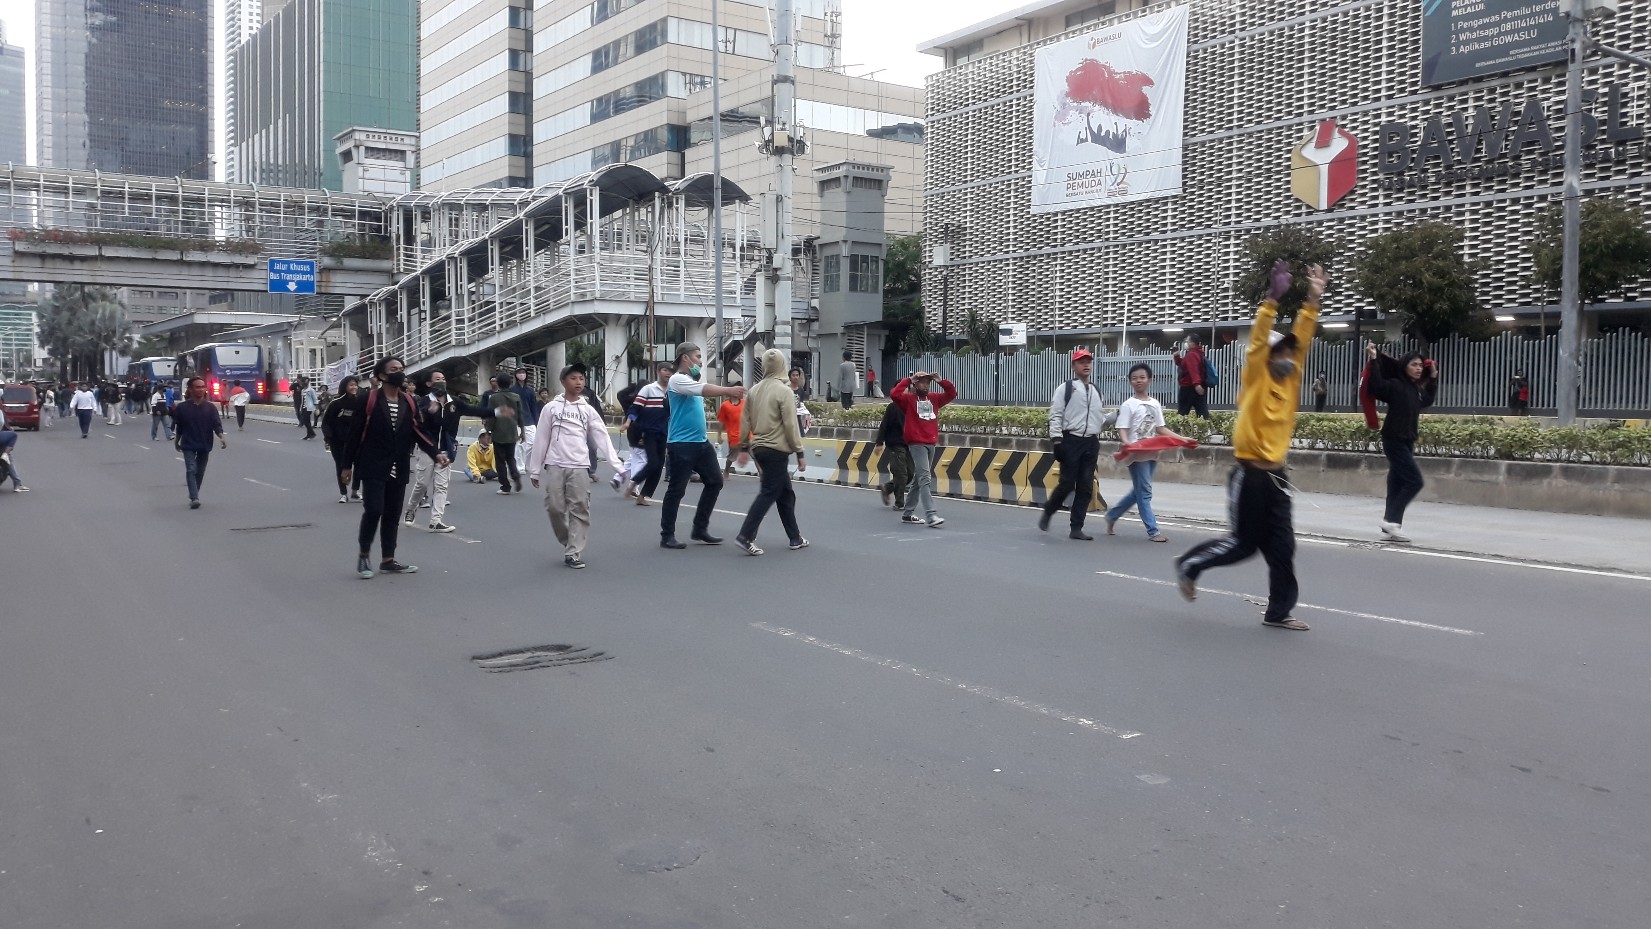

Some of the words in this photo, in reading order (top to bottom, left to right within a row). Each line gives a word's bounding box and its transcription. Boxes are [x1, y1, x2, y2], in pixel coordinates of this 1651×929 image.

[1458, 14, 1500, 29] Pengawas
[1501, 6, 1531, 20] Pemilu
[1450, 46, 1457, 55] 3.
[1459, 38, 1492, 54] Aplikasi
[1492, 28, 1537, 46] GOWASLU
[1451, 34, 1457, 43] 2.
[1459, 26, 1500, 41] Whatsapp
[1378, 81, 1651, 174] BAWASL
[1066, 168, 1102, 181] SUMPAH
[1066, 179, 1102, 191] PEMUDA
[290, 263, 310, 271] Khusus
[281, 272, 313, 282] Transjakarta
